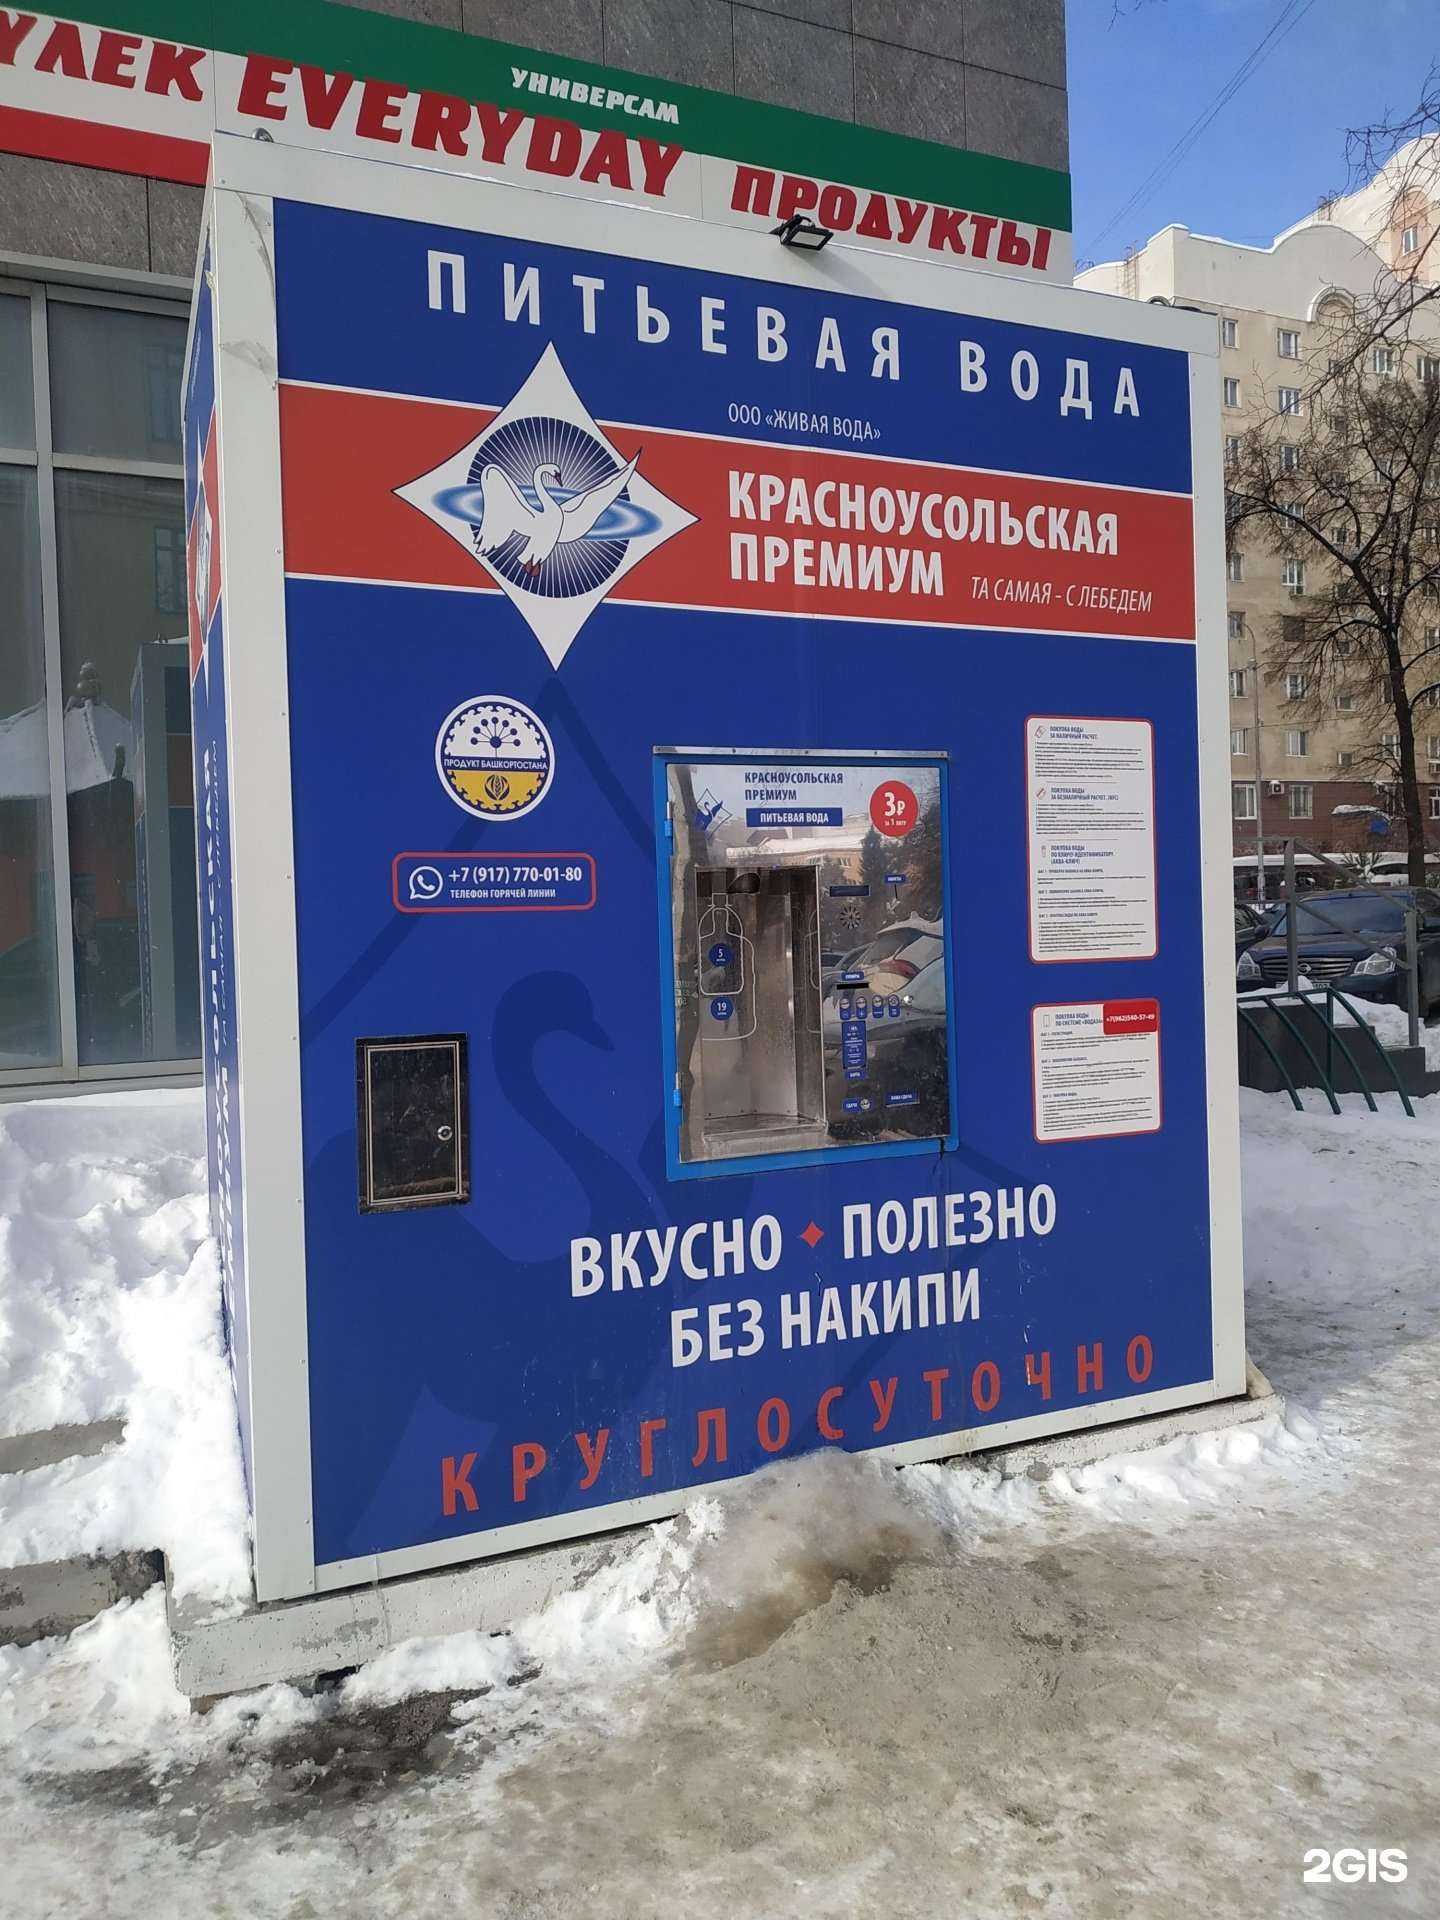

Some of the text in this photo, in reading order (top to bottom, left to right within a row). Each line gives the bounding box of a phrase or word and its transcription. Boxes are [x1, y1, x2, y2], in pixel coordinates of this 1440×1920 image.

[237, 51, 684, 197] EVERYDAY
[510, 65, 680, 126] УНИВЕРСАМ
[730, 164, 1053, 270] ПРОДУКТЫ
[427, 249, 1140, 421] ПИТЬЕВАЯ ВОДА
[728, 402, 881, 443] ООО «ЖИВАЯ ВОДА»
[728, 470, 1119, 556] КРАСНОУСОЛЬСКАЯ
[730, 532, 944, 597] ПРЕМИУМ
[971, 575, 989, 600] ТА
[993, 577, 1052, 605] САМАЯ
[1066, 584, 1076, 607] С
[1077, 585, 1153, 615] ЛЕБЕДЕМ
[443, 758, 548, 771] ПРОДУКТ БАШКОРТОСТАНА
[745, 771, 843, 785] КРАСНОУСОЛЬСКАЯ
[745, 788, 797, 801] ПРЕМИУМ
[760, 812, 829, 824] ПИТЬЕВАЯ ВОДА
[448, 866, 582, 886] +7 (917) 770-01-80
[450, 887, 556, 899] ТЕЛЕФОН ГОРЯЧЕЙ ЛИНИИ
[569, 1183, 1057, 1298] ВКУСНО ПОЛЕЗНО
[671, 1266, 980, 1369] БЕЗ НАКИПИ
[441, 1334, 1153, 1518] КРУГЛОСУТОЧНО
